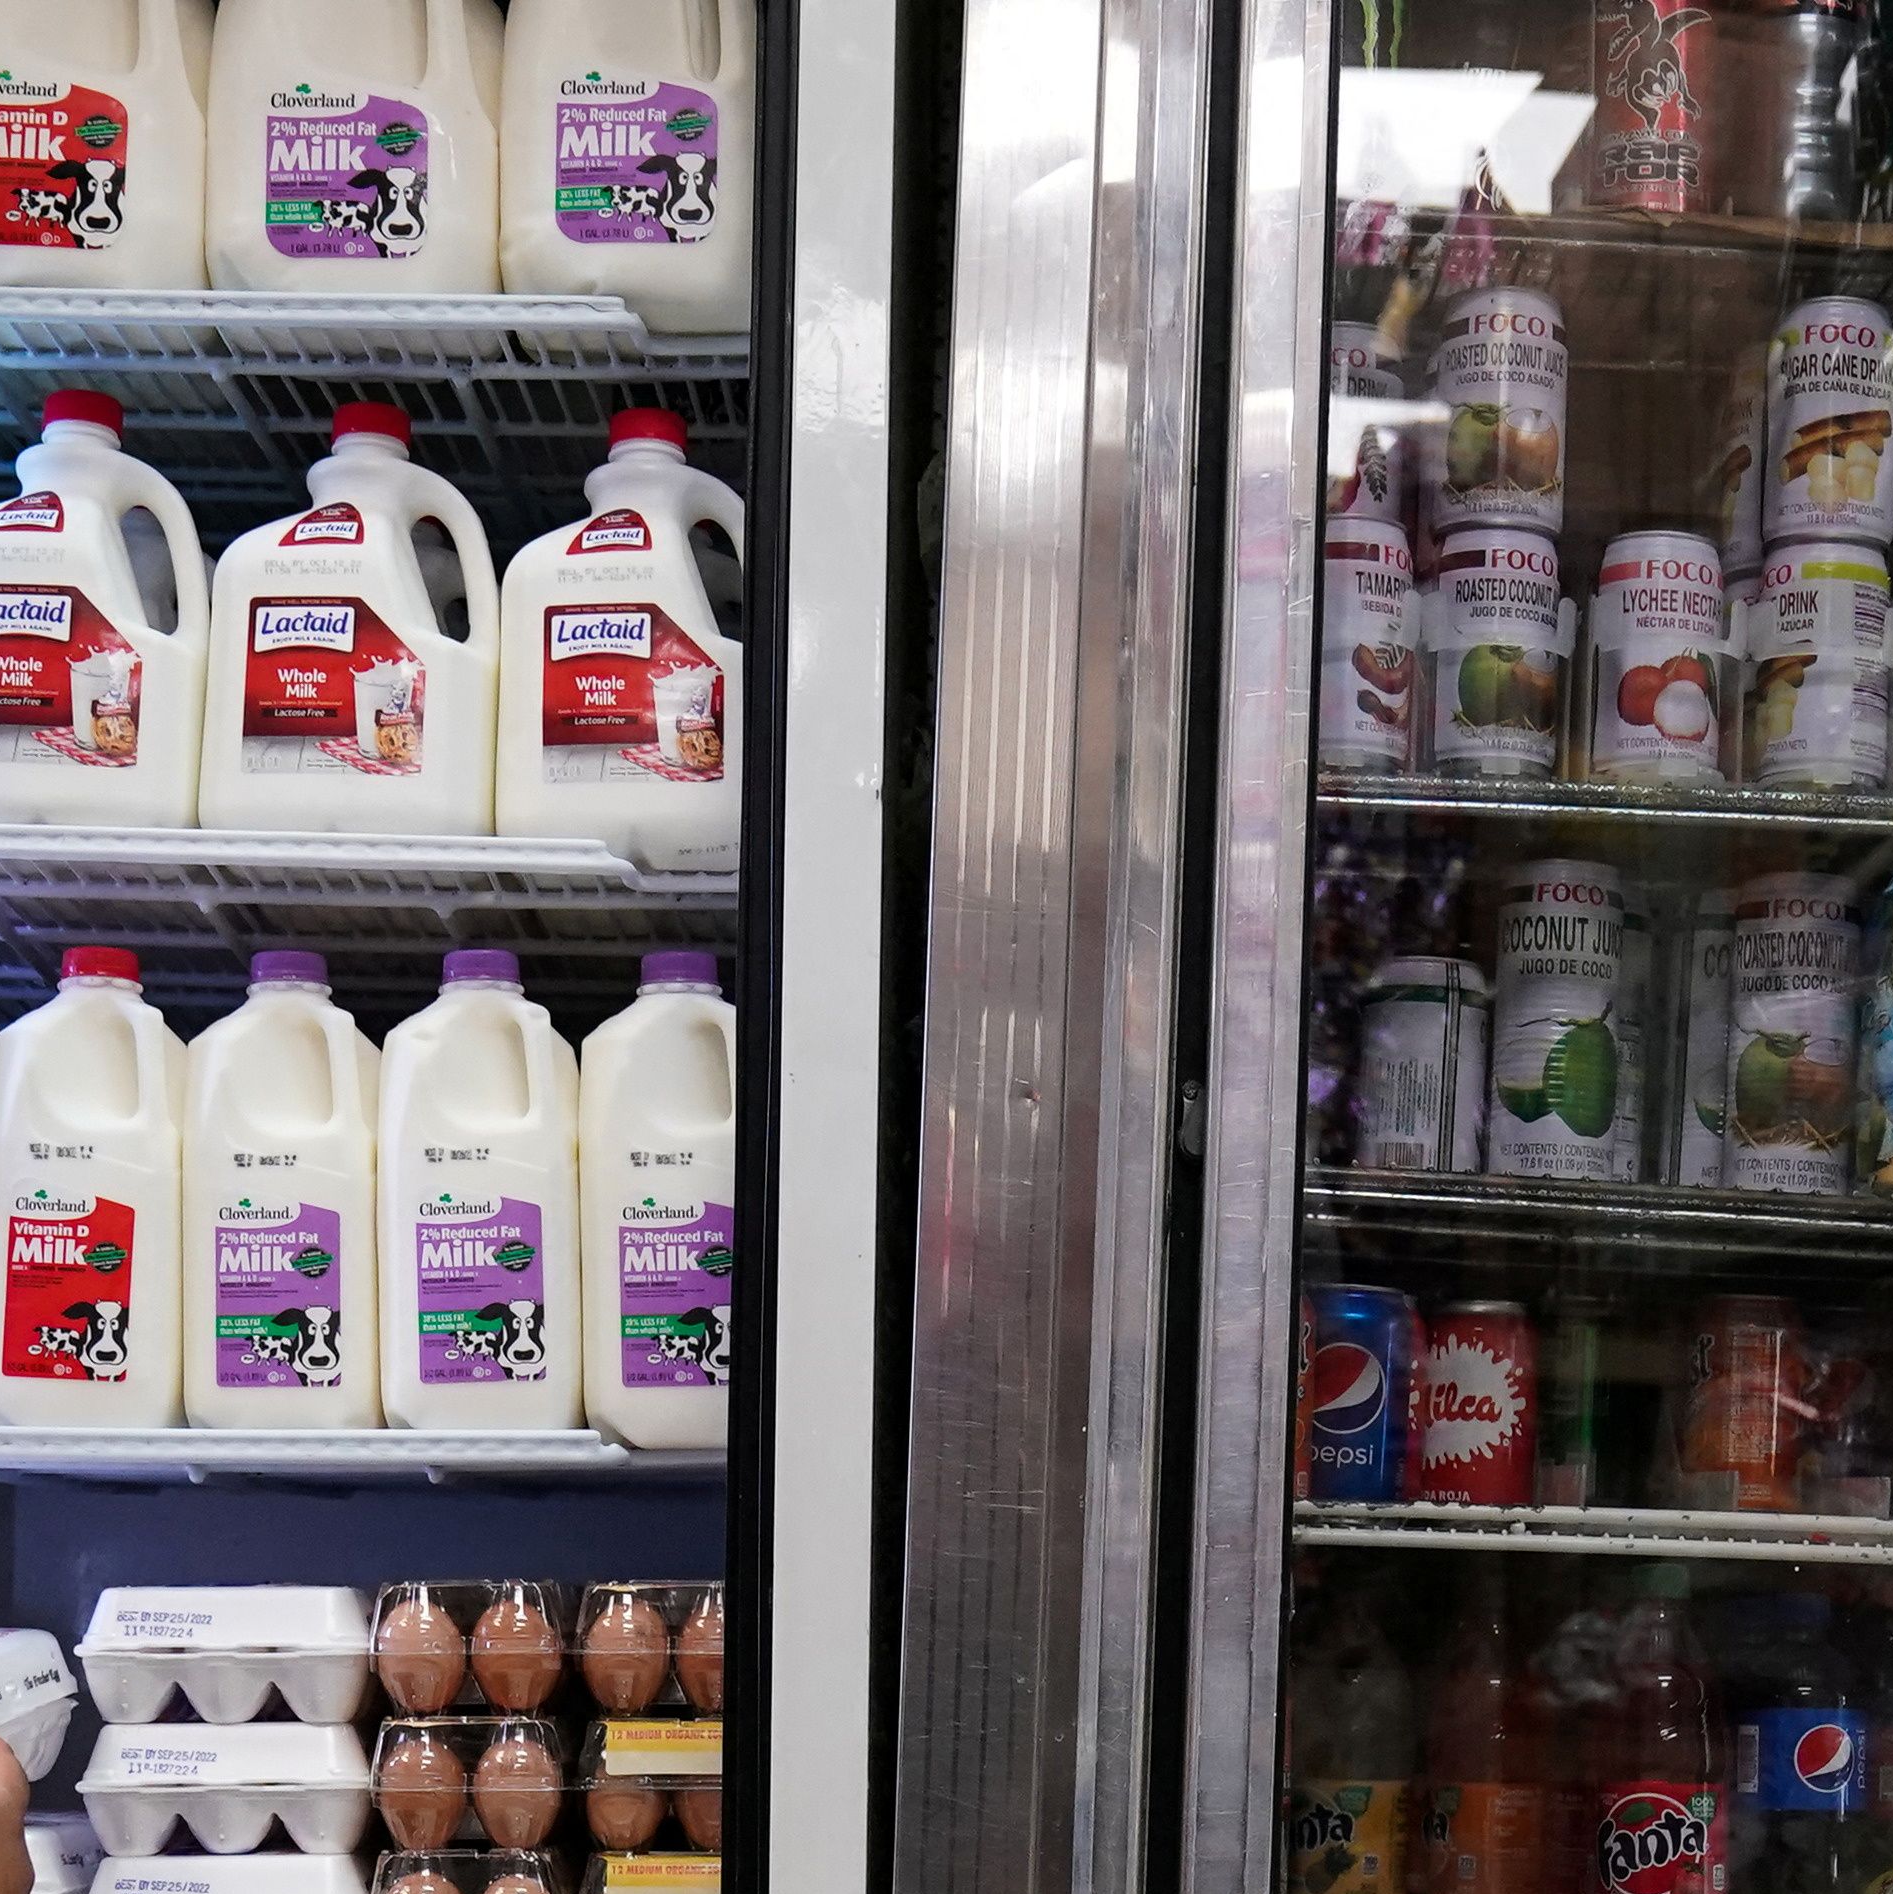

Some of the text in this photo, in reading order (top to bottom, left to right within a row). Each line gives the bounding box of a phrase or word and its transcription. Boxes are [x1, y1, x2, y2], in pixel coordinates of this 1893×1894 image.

[560, 80, 646, 97] Cloverland
[270, 92, 356, 110] Cloverland
[52, 110, 69, 126] D
[560, 107, 667, 124] 2% Reduced Fat
[270, 122, 377, 136] 2% Reduced Fat
[559, 122, 657, 158] Milk
[269, 136, 366, 171] Milk
[1474, 313, 1545, 336] FOCO
[1805, 324, 1876, 348] FOCO
[1822, 353, 1858, 377] CANE
[1491, 549, 1554, 576] FOCO
[1647, 560, 1713, 585] FOCO
[1456, 578, 1507, 604] ROASTED
[1622, 589, 1677, 614] LYCHEE
[1779, 590, 1819, 617] DRINK
[1469, 606, 1540, 621] JUGO DE COCO
[261, 611, 348, 635] Lactaid
[558, 618, 645, 643] Lactaid
[1, 672, 33, 687] Milk
[278, 668, 327, 683] Whole
[576, 675, 625, 690] Whole
[286, 684, 317, 698] Milk
[584, 691, 617, 706] Milk
[23, 697, 41, 706] Free
[274, 708, 306, 717] Lactose
[574, 717, 606, 725] Lactose
[1537, 883, 1604, 906] FOCO
[1768, 899, 1842, 920] FOCO
[1518, 958, 1613, 980] JUGO DE COCO
[15, 1198, 86, 1215] Cloverland
[219, 1206, 290, 1221] Cloverland
[419, 1202, 491, 1217] Cloverland
[623, 1205, 694, 1220] Cloverland
[14, 1222, 90, 1238] Vitamin D
[219, 1230, 319, 1244] 2% Reduced Fat
[420, 1225, 521, 1241] 2% Reduced Fat
[623, 1231, 724, 1244] 2% Reduced Fat
[13, 1238, 87, 1266] Milk
[219, 1244, 294, 1273] Milk
[421, 1239, 497, 1268] Milk
[622, 1243, 699, 1273] Milk
[1311, 1444, 1375, 1469] pepsi
[626, 1729, 661, 1739] MEDIUM
[1597, 1810, 1707, 1891] Fanta
